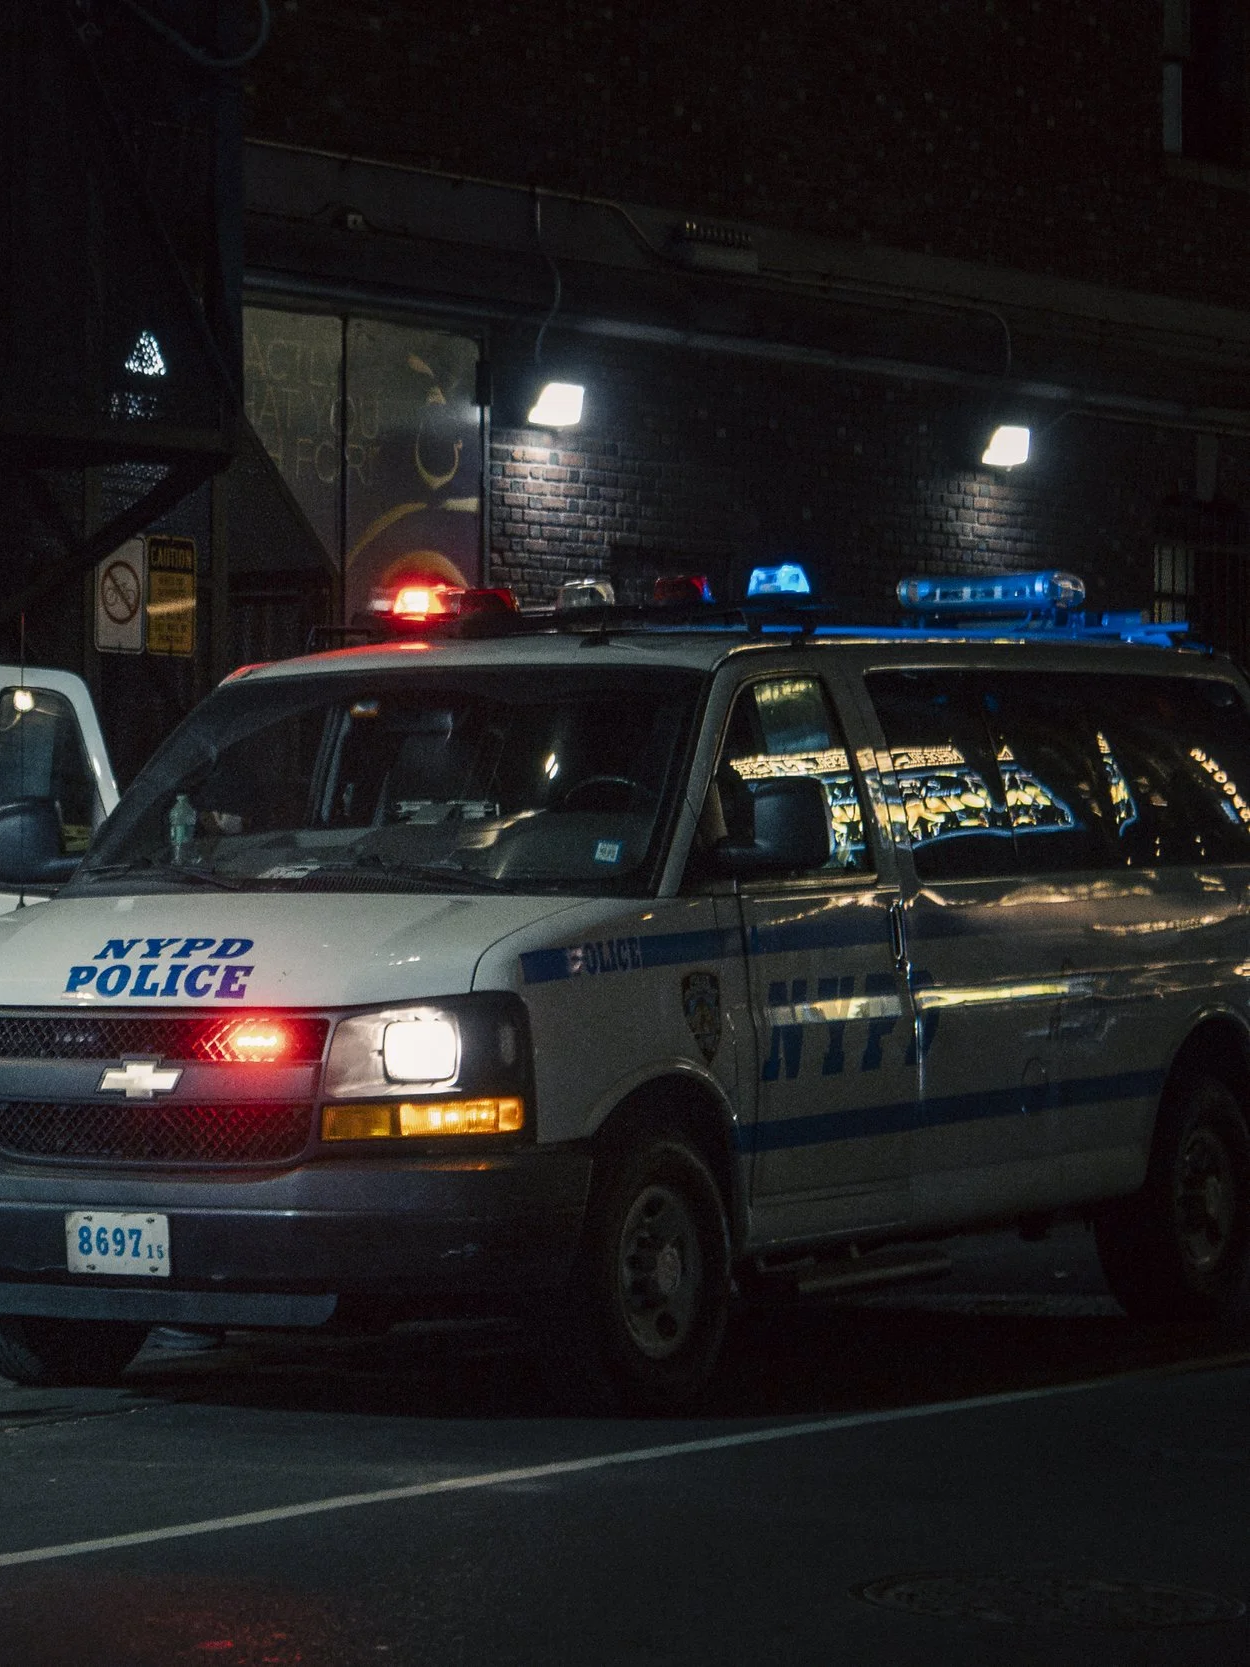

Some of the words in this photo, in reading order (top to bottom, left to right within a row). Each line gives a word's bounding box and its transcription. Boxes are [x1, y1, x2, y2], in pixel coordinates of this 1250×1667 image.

[92, 938, 254, 960] NYPD
[567, 936, 643, 977] POLICE
[60, 964, 255, 1000] POLICE
[761, 969, 941, 1082] NYPD
[78, 1225, 143, 1258] 8697
